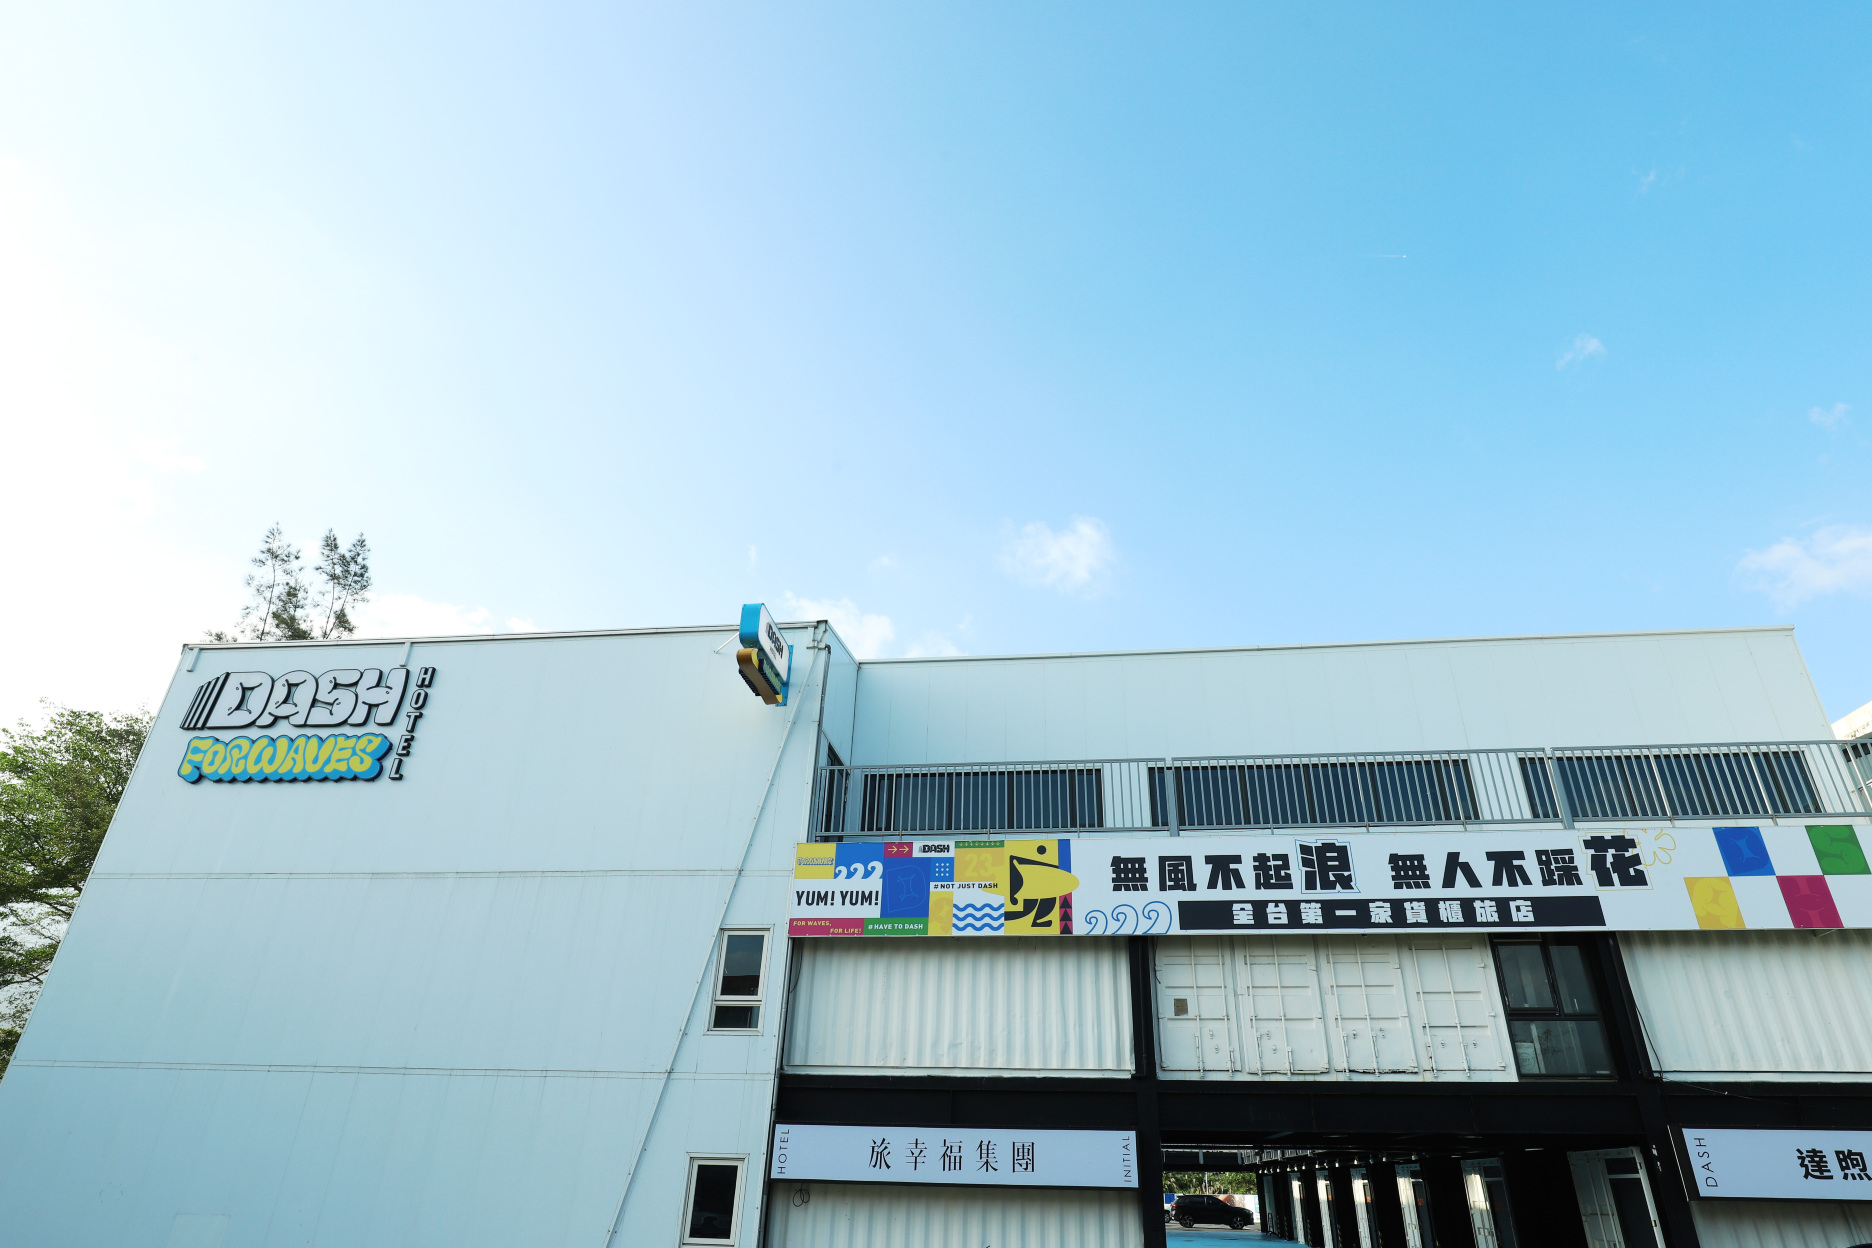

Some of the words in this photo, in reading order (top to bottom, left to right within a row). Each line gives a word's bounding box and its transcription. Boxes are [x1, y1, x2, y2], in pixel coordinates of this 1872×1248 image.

[203, 668, 410, 729] DASH
[388, 666, 436, 780] HOTEL
[178, 733, 392, 783] FORWAVES
[922, 844, 950, 854] DASH
[965, 853, 993, 878] 23
[1110, 842, 1357, 892] 無風不起浪
[1388, 834, 1648, 889] 無人不踩花
[796, 890, 835, 906] YUM!
[840, 890, 879, 906] YUM!
[1232, 900, 1535, 924] 全台第一家貨櫃旅店
[777, 1128, 790, 1175] HOTEL
[868, 1137, 1035, 1174] 旅幸福集團
[1123, 1135, 1132, 1183] INITIAL
[1694, 1137, 1719, 1188] DASH
[1796, 1148, 1872, 1181] 達煦
